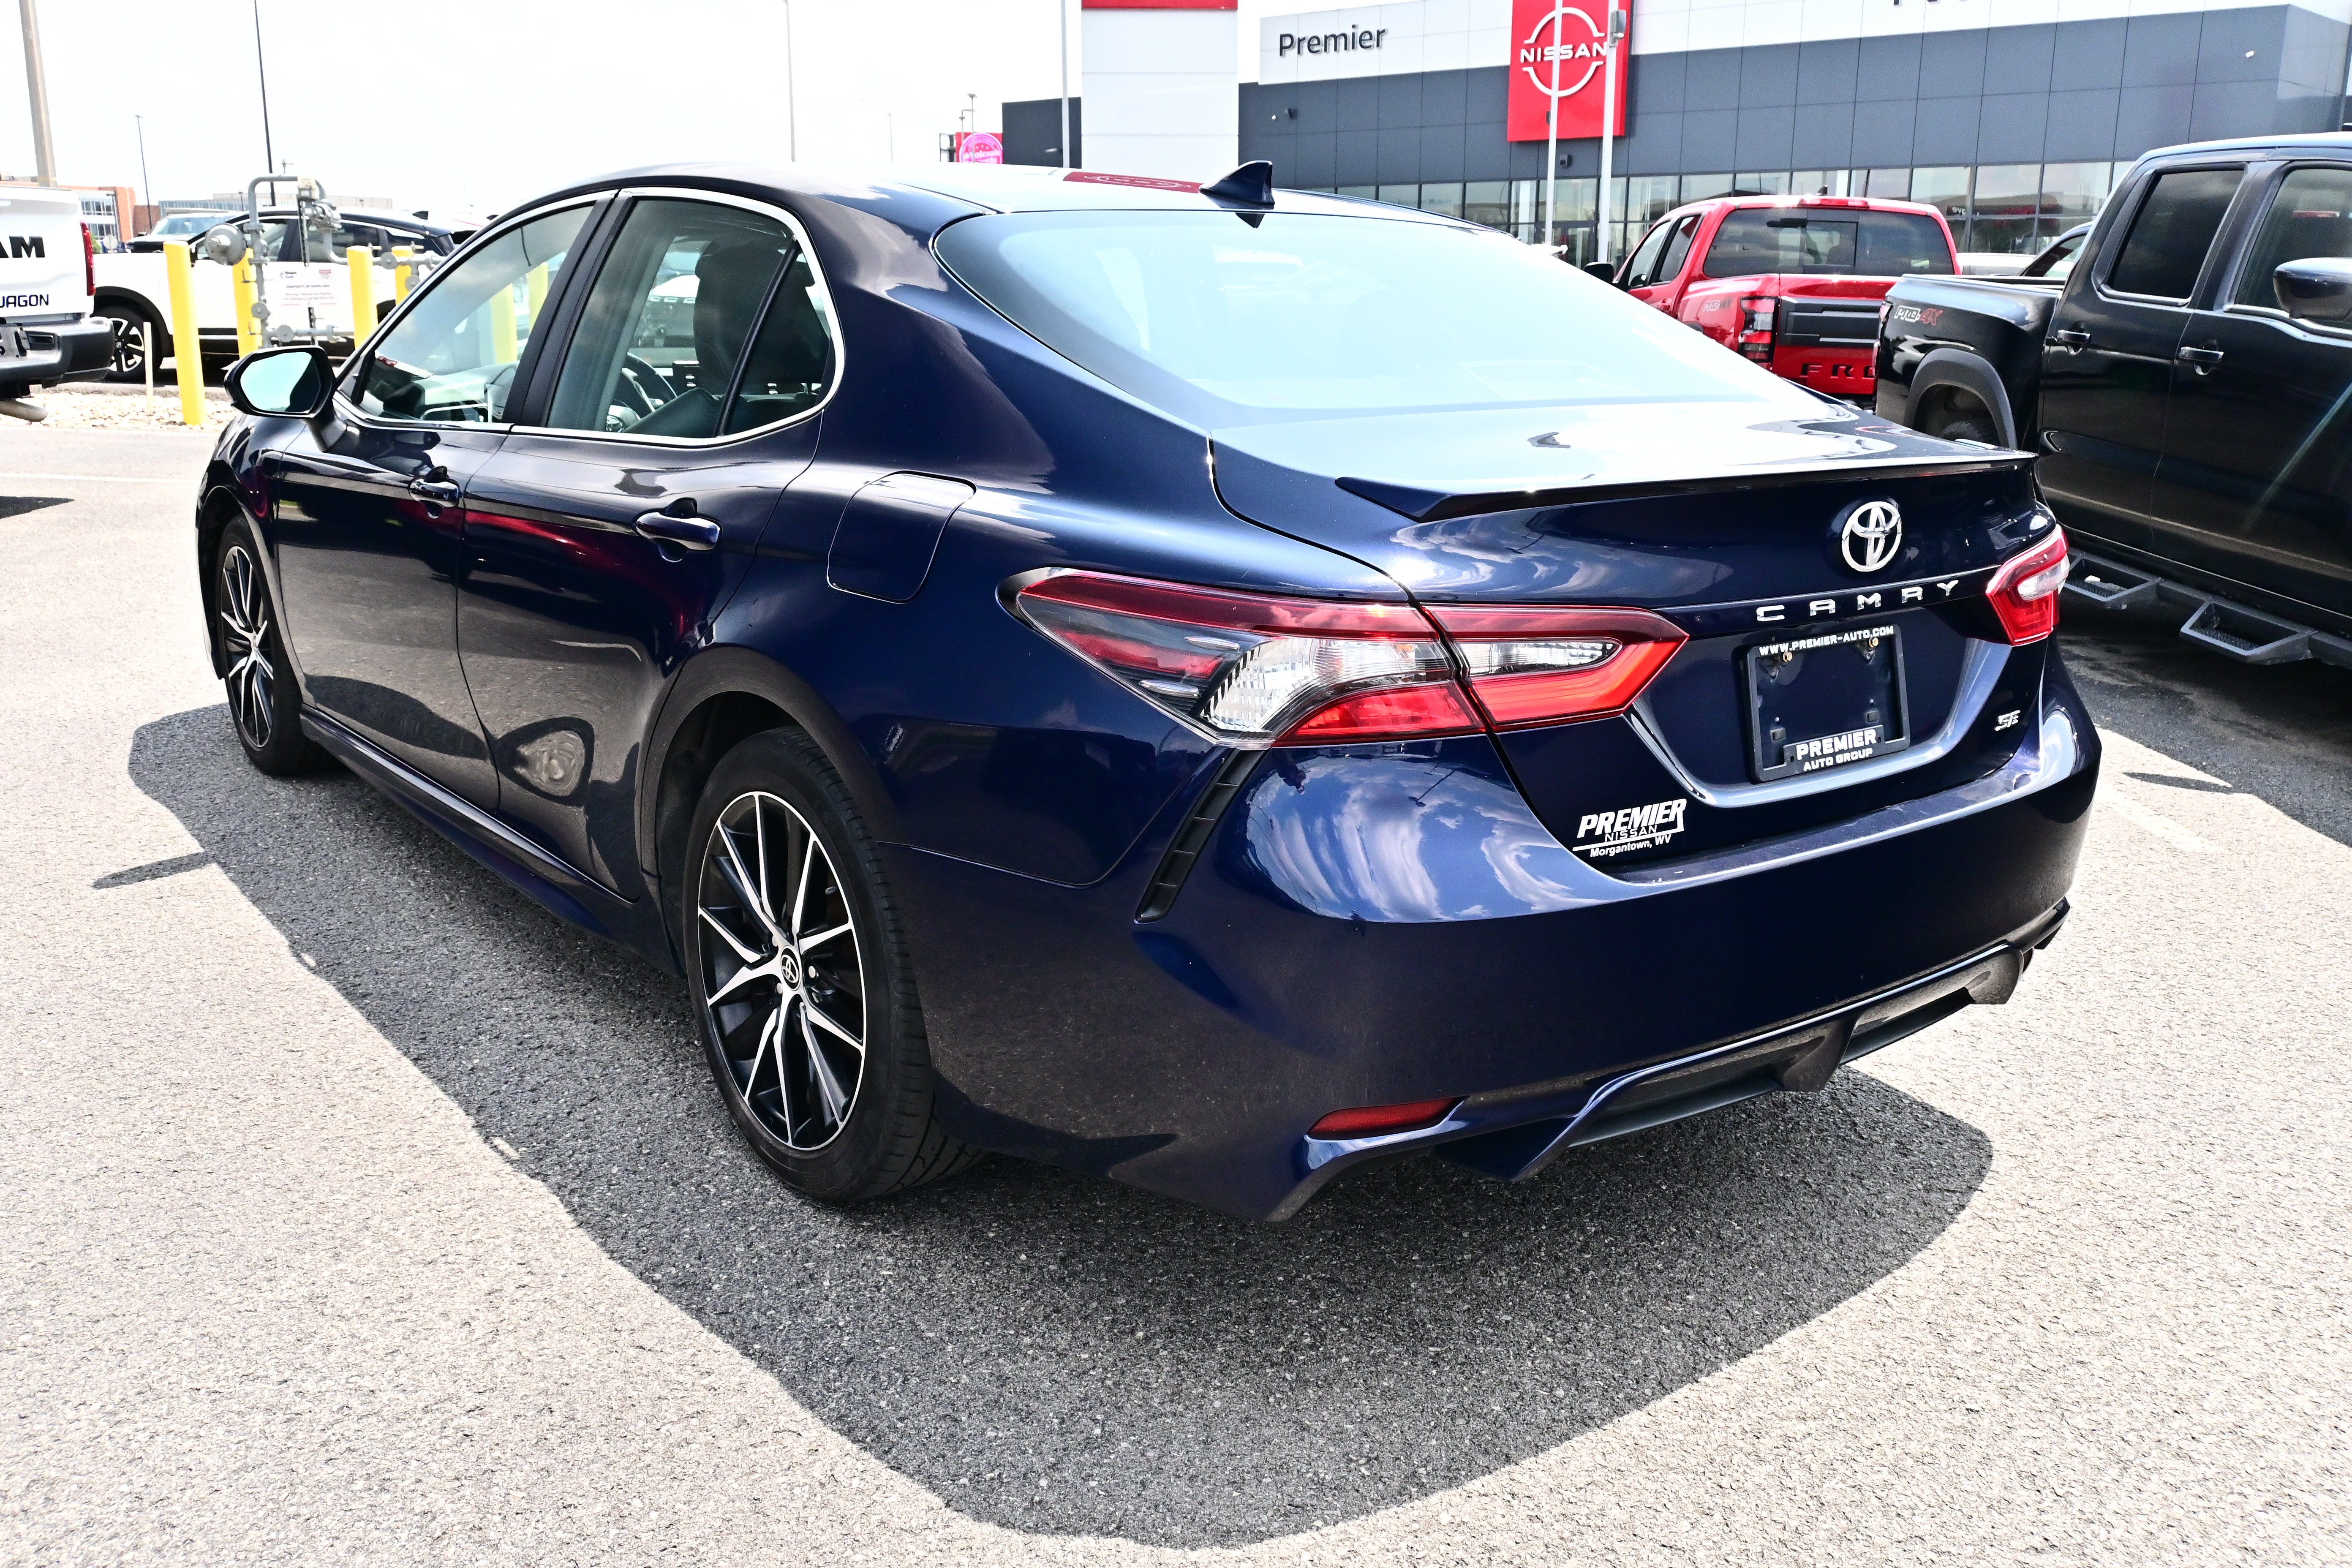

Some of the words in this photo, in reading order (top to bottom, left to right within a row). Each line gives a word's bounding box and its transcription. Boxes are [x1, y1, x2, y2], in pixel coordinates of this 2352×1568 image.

[1279, 24, 1387, 57] Premier
[1520, 41, 1607, 63] NISSAN
[0, 235, 45, 258] M
[1756, 580, 1959, 622] CAMRY
[1759, 626, 1894, 656] WWW.PREMIER-AUTO.COM
[1995, 710, 2021, 731] SE
[1796, 729, 1877, 760] PREMIER
[1803, 757, 1834, 771] AUTO
[1835, 748, 1873, 764] GROUP
[1576, 798, 1687, 838] PREMIER
[1605, 824, 1657, 842] NISSAN
[1590, 840, 1652, 858] Morgantown,
[1655, 834, 1672, 845] WV
